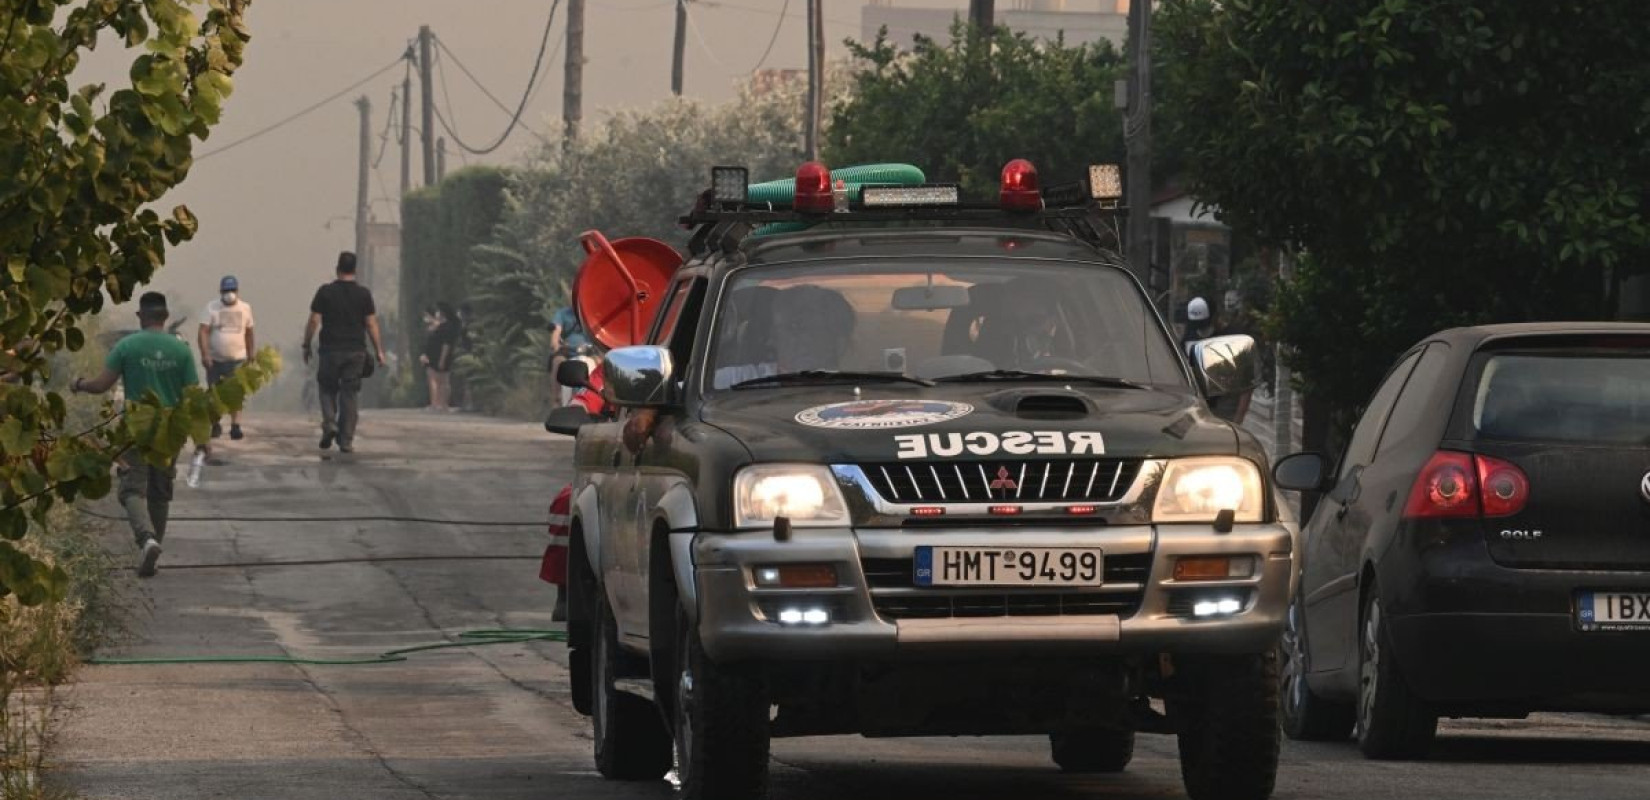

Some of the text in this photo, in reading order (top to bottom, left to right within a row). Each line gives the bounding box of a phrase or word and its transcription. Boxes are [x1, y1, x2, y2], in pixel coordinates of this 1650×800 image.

[1500, 530, 1542, 540] GOLF
[916, 550, 1097, 581] GR HMT-9499
[1607, 594, 1650, 620] IBX
